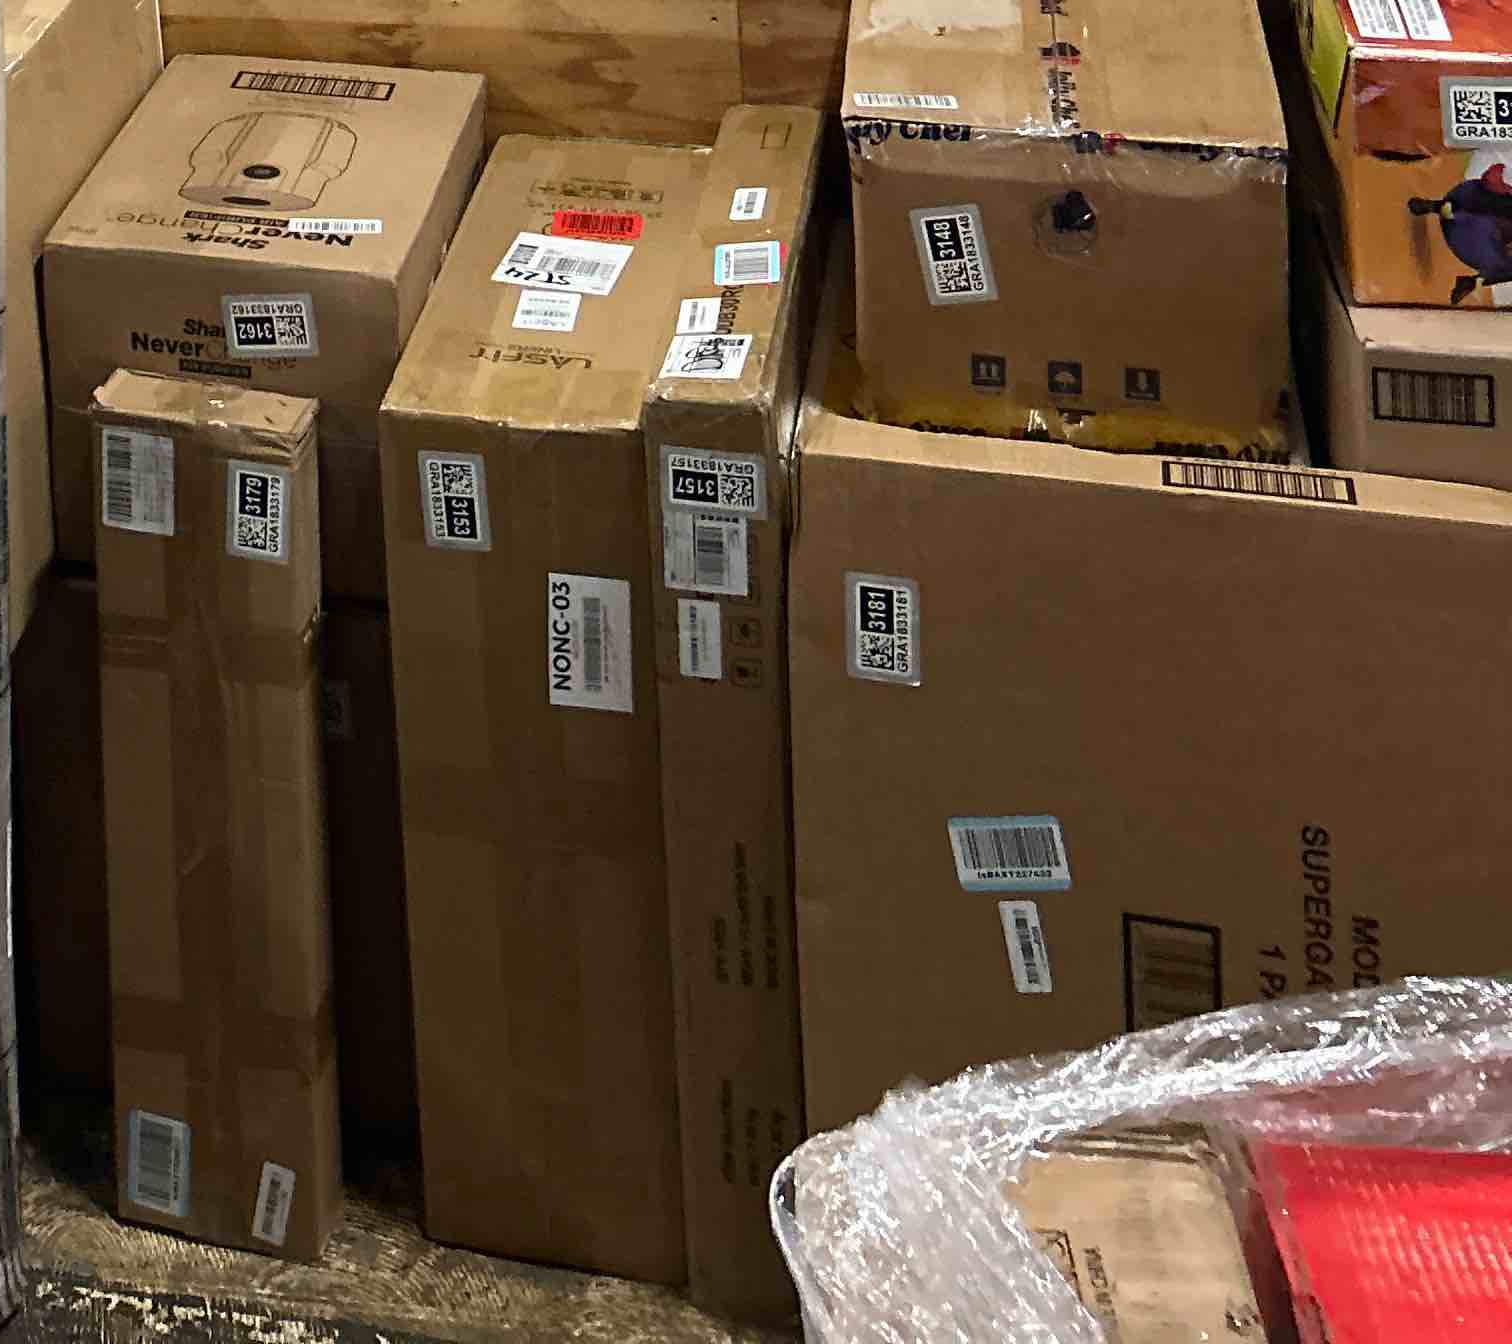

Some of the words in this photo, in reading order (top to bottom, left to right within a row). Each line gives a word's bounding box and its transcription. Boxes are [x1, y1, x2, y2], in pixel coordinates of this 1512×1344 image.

[179, 232, 271, 251] Shark
[938, 220, 956, 258] 3148
[958, 215, 986, 293] GRA1833148
[182, 317, 226, 339] Sha
[238, 321, 273, 340] 3162
[466, 348, 594, 371] LASFIT
[670, 456, 755, 475] GRA1833157
[245, 477, 264, 515] 3179
[674, 477, 718, 497] 3157
[267, 476, 282, 554] GRA1833179
[451, 498, 473, 538] 3153
[867, 589, 887, 632] 3181
[551, 580, 572, 692] NONC-03
[1300, 824, 1335, 991] SUPERGA
[1259, 942, 1286, 960] 1
